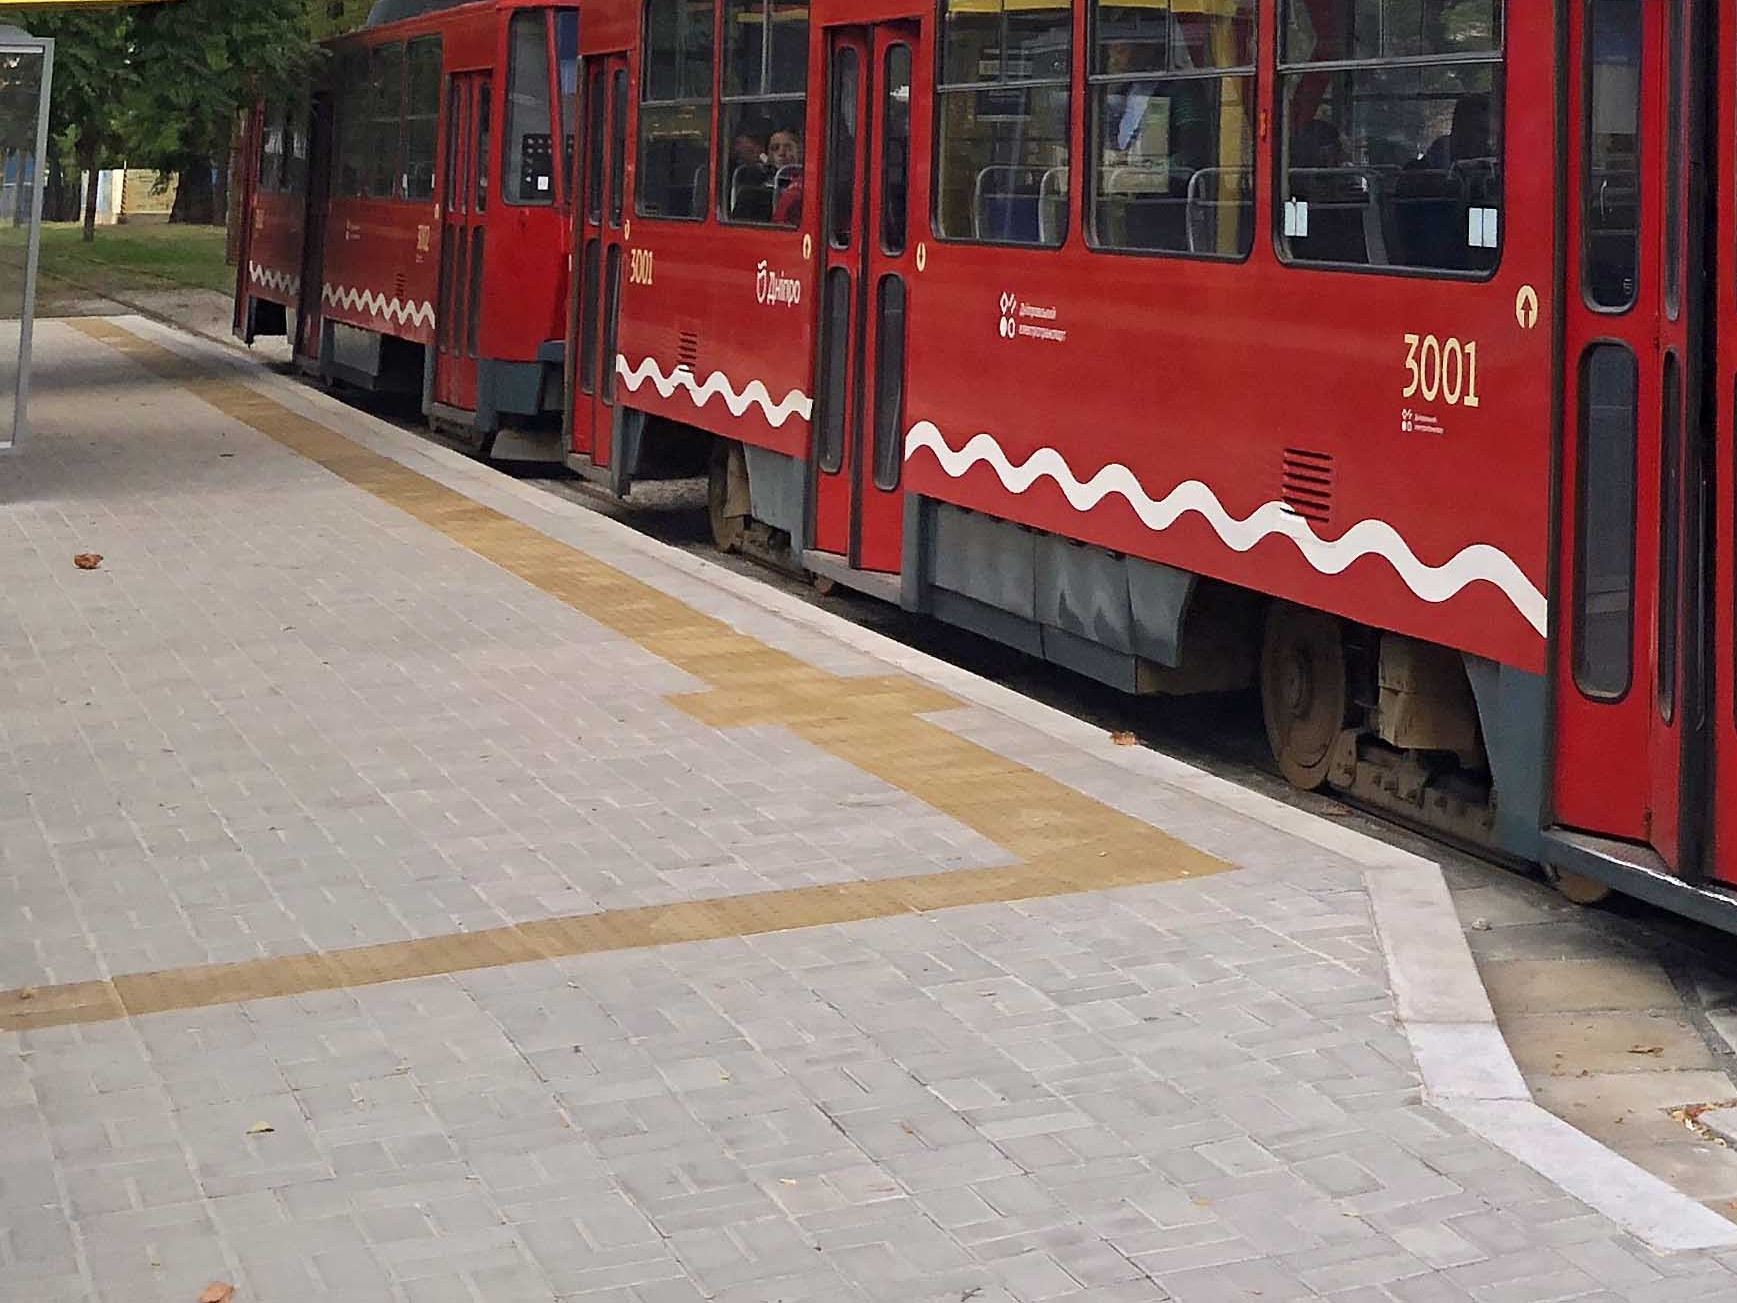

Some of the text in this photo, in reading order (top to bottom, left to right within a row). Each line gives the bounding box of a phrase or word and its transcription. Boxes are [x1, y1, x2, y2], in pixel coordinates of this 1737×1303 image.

[630, 249, 653, 285] 3001
[766, 269, 801, 308] Дніпро
[1402, 333, 1479, 407] 3001
